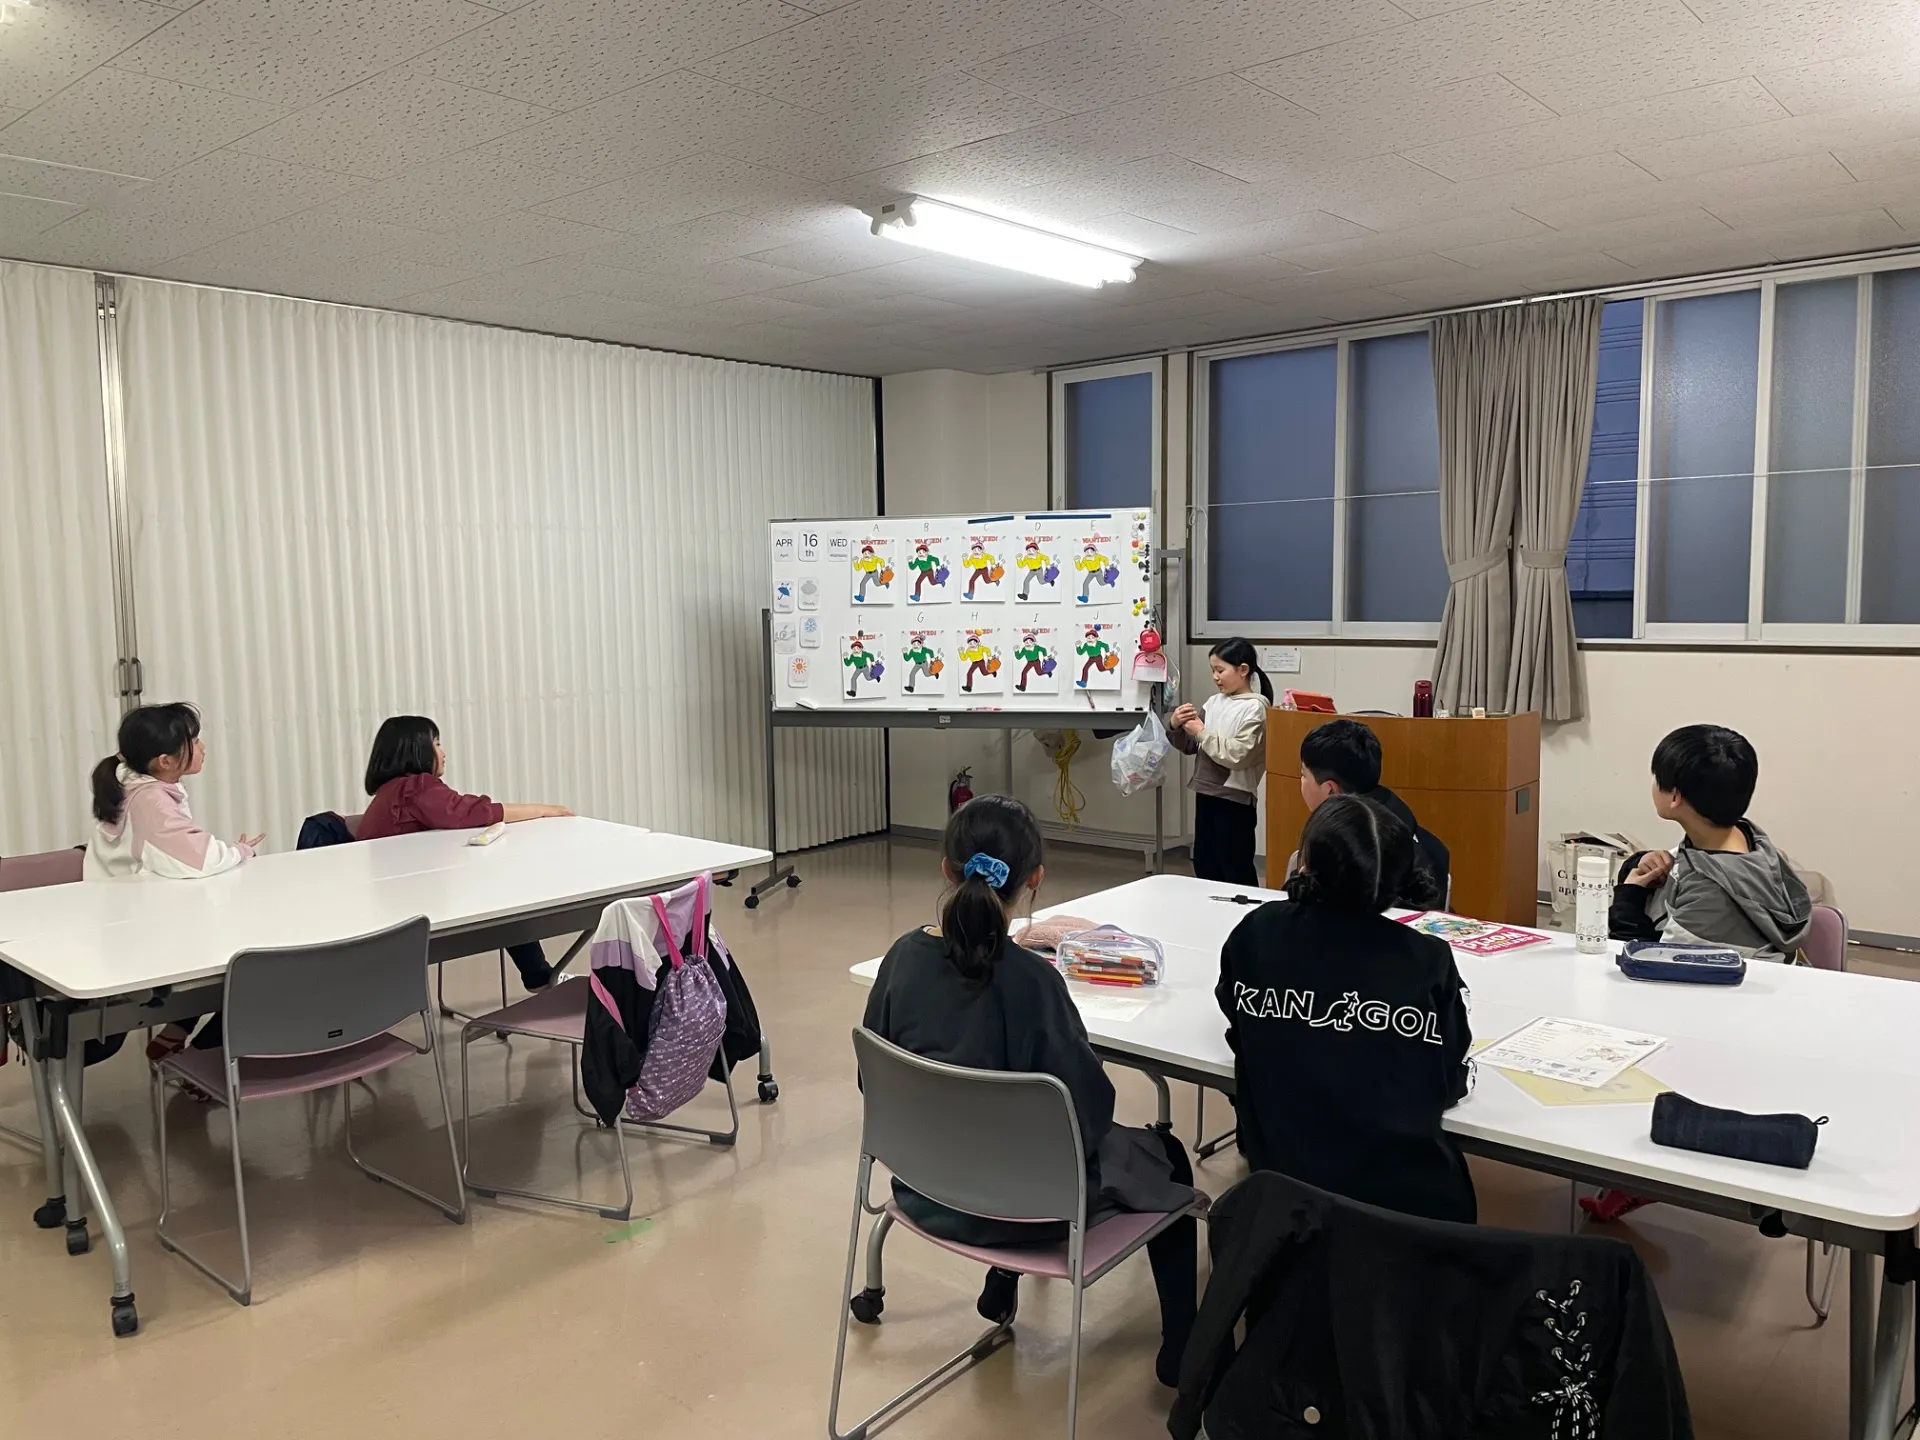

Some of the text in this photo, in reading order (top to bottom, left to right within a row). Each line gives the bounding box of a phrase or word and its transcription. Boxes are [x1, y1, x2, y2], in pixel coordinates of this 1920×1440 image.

[873, 524, 880, 532] A
[1034, 522, 1042, 531] D
[775, 538, 793, 547] APR
[803, 533, 818, 547] 16
[829, 538, 848, 547] WED
[805, 549, 814, 557] th
[917, 611, 925, 623] G
